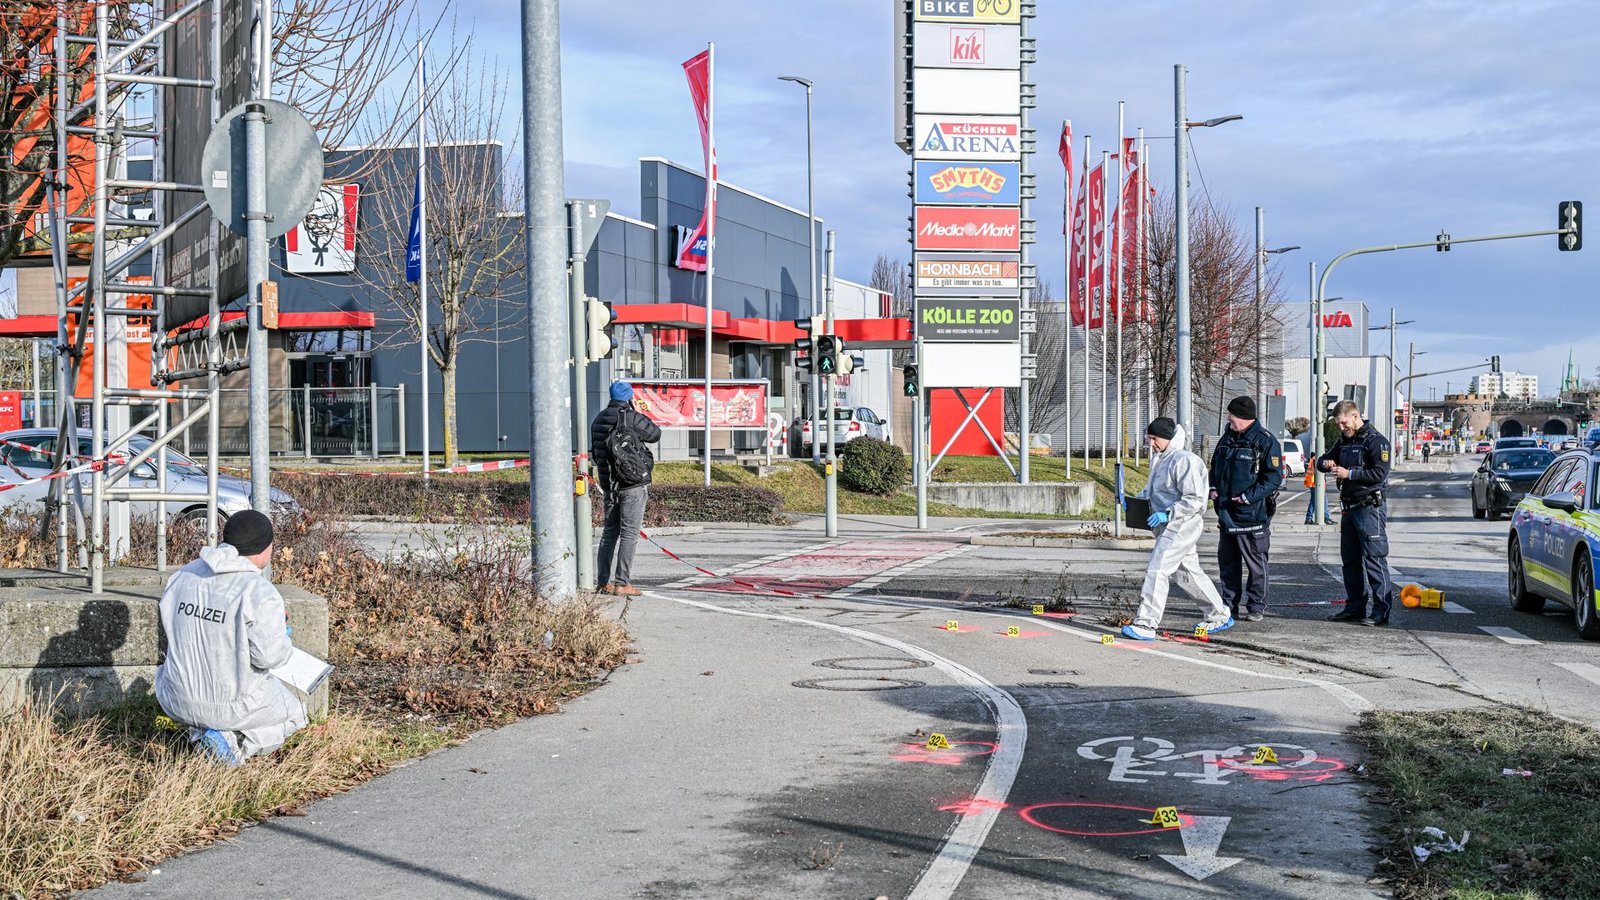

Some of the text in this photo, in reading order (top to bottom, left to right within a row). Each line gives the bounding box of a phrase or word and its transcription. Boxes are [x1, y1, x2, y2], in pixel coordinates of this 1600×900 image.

[924, 1, 969, 13] BIKE
[953, 33, 982, 60] kik
[952, 124, 1007, 134] KÜCHEN
[918, 123, 1017, 153] ARENA
[932, 170, 1004, 191] SMYTHS
[919, 222, 1017, 236] Media Markt
[920, 264, 1001, 276] HORNBACH
[941, 279, 952, 287] gibt
[923, 306, 1013, 324] KÖLLE ZOO
[1544, 533, 1565, 560] POLIZEI
[177, 602, 226, 624] POLIZEI
[1008, 627, 1018, 635] 35
[928, 735, 941, 746] 32
[1255, 748, 1268, 759] 31
[1161, 810, 1179, 823] 33
